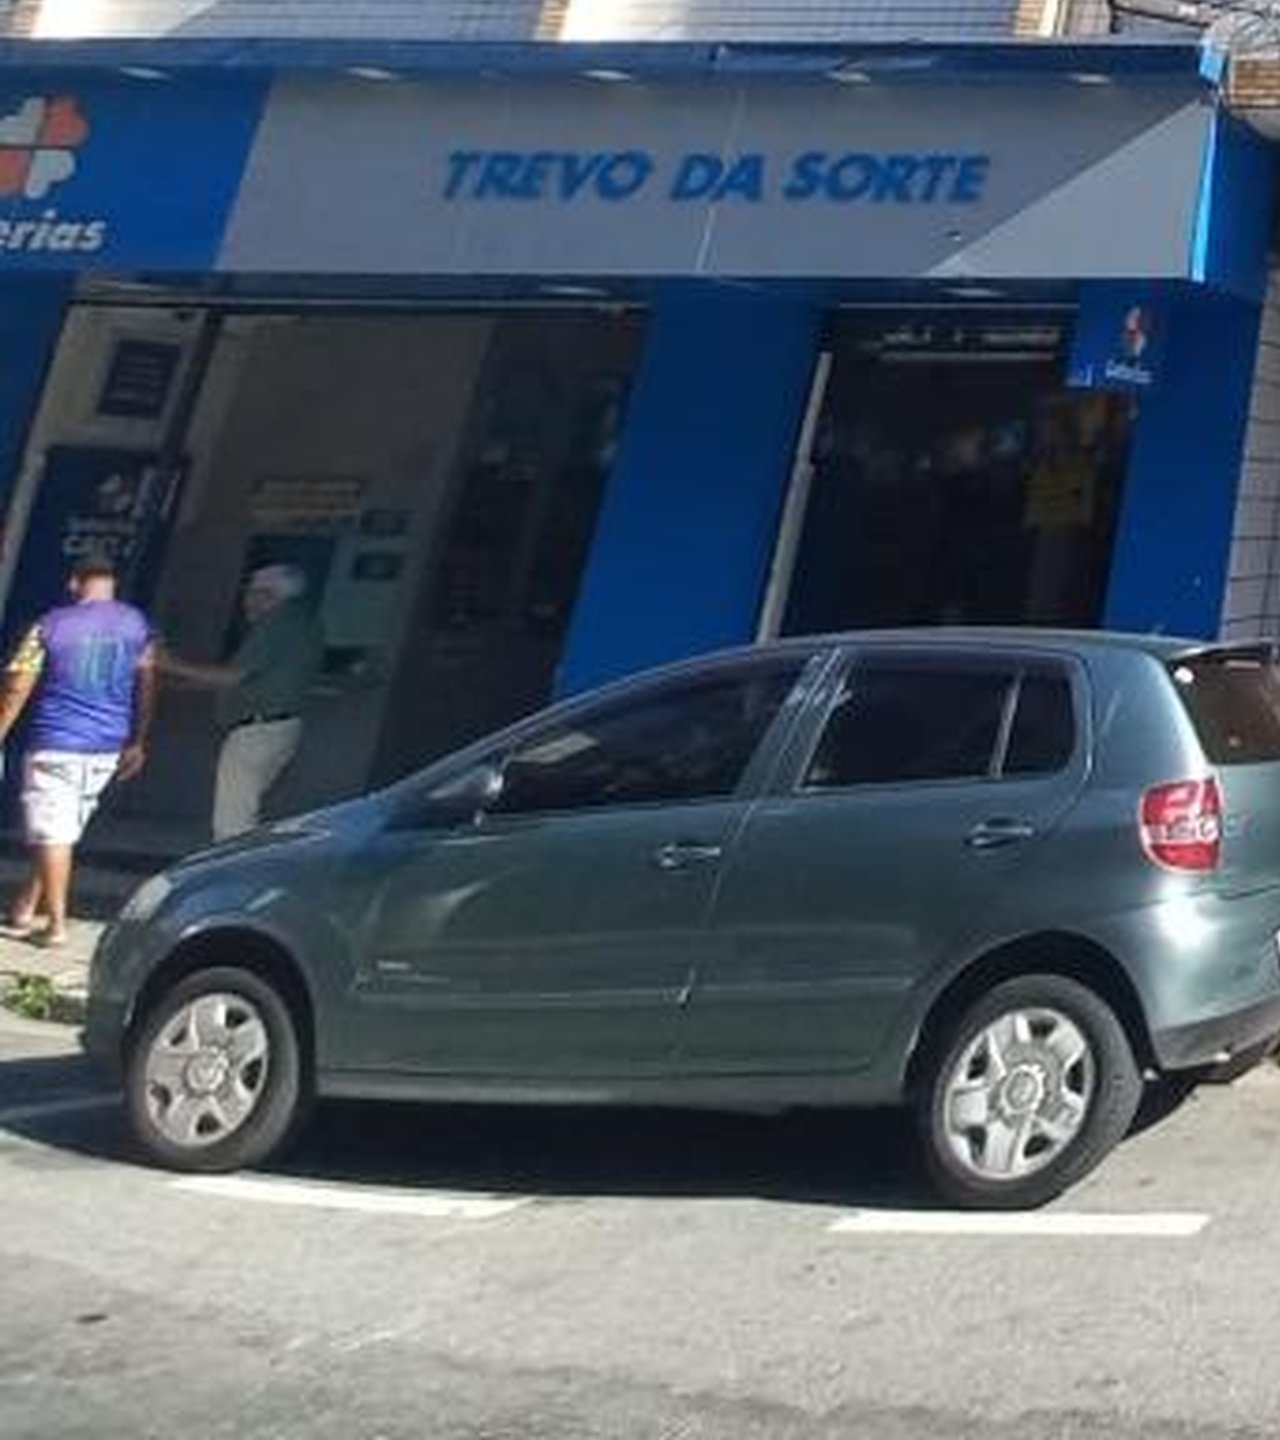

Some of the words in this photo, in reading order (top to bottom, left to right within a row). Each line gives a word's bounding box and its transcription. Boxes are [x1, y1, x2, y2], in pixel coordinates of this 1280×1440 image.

[443, 151, 655, 200] TREVO
[668, 151, 764, 202] DA
[780, 151, 990, 203] SORTE
